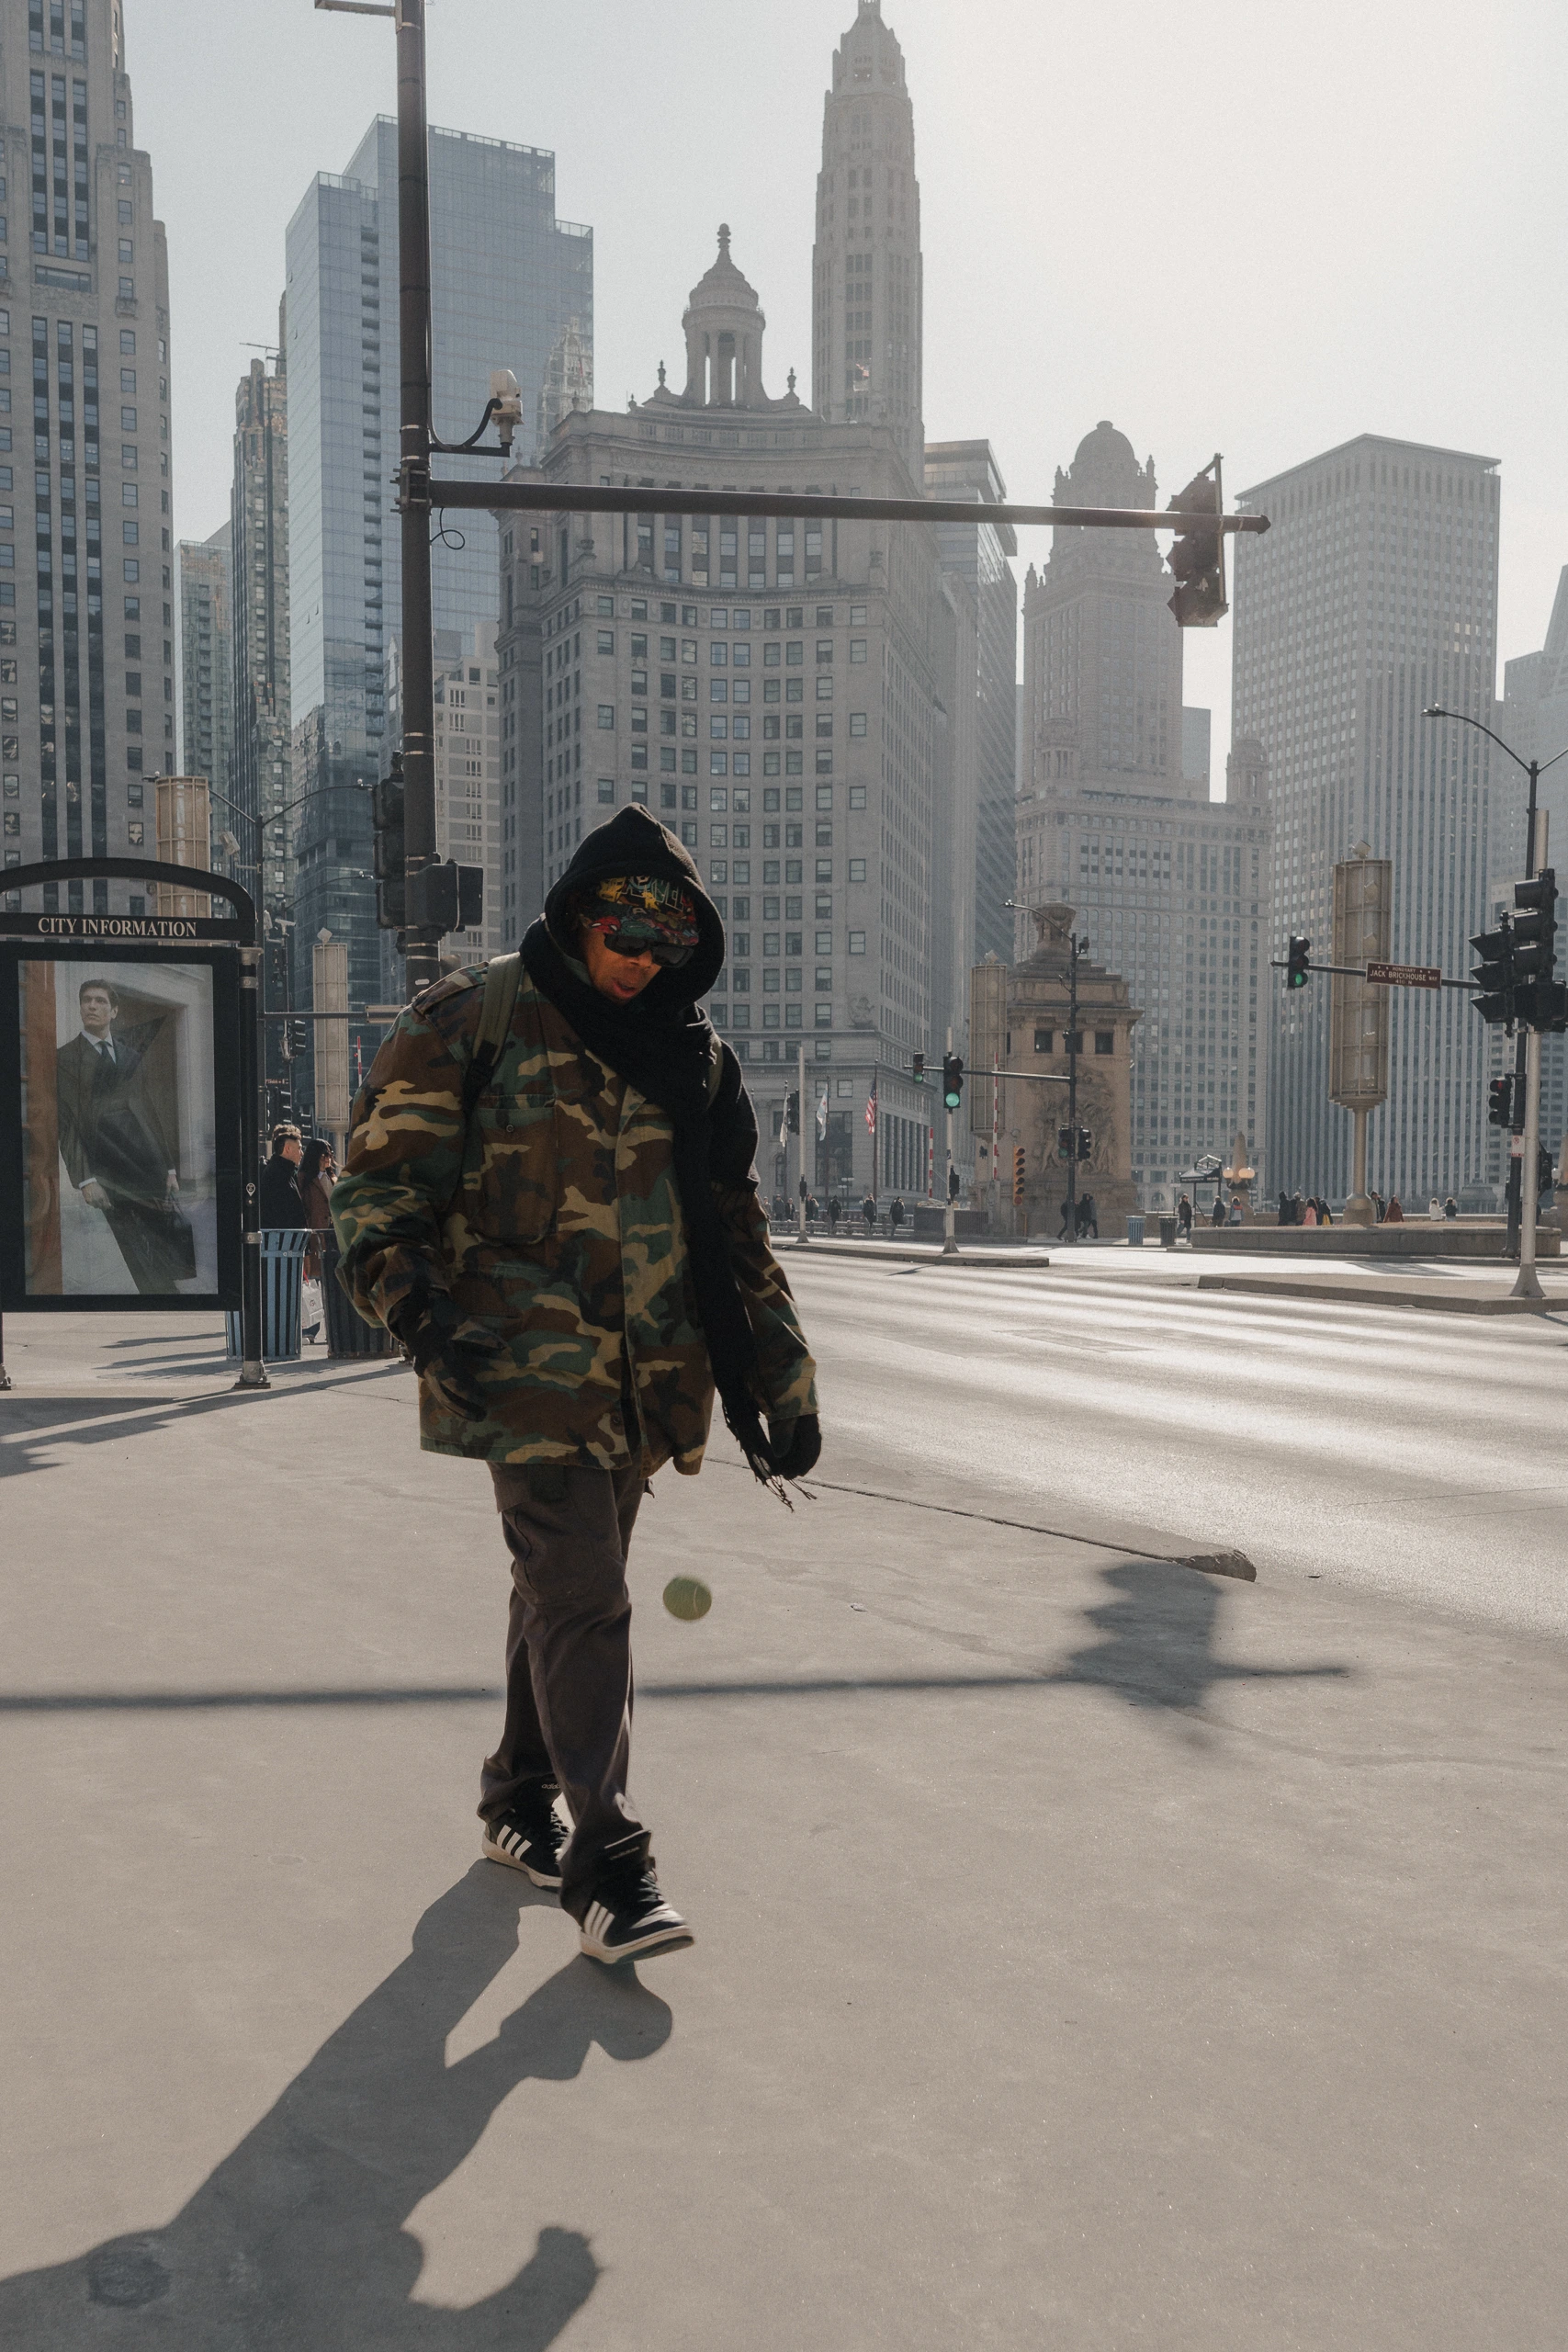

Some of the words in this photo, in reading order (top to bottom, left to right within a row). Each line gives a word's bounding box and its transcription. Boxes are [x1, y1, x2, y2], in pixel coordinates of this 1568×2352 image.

[38, 917, 77, 933] CITY
[82, 918, 197, 936] INFORMATION
[1389, 971, 1426, 981] BRICKHOUSE
